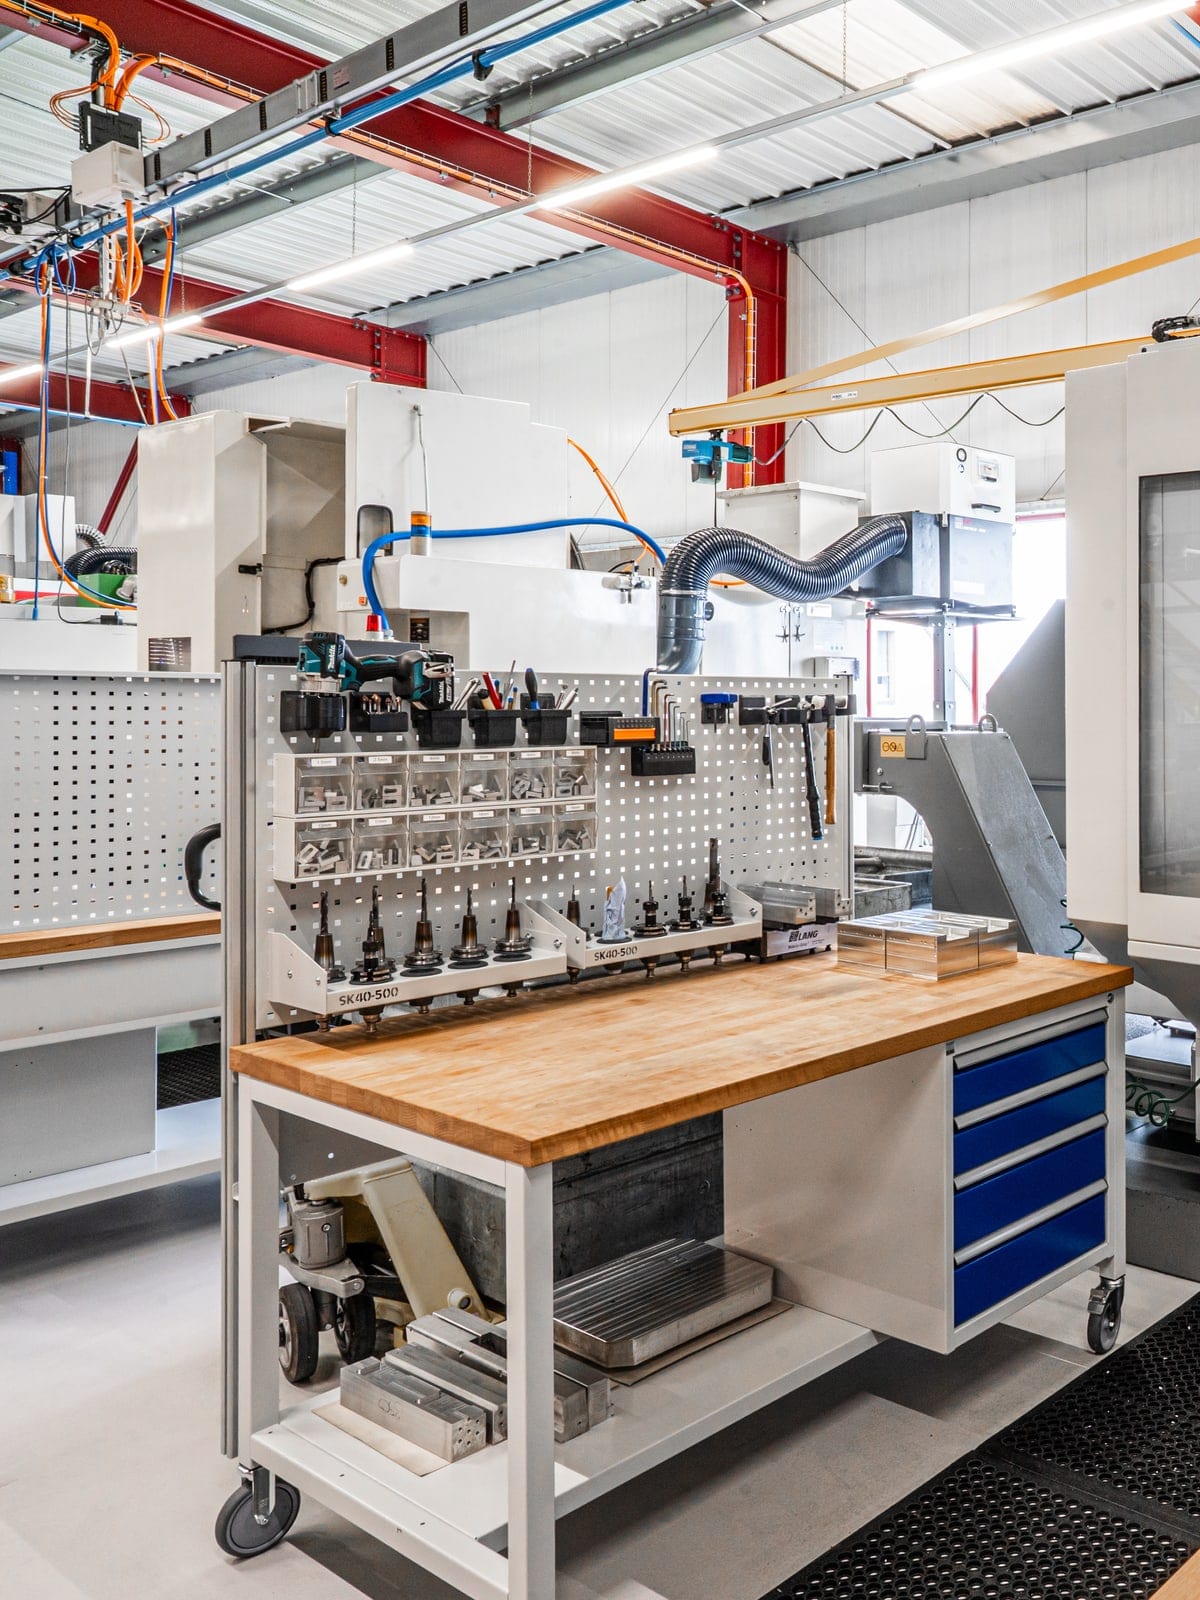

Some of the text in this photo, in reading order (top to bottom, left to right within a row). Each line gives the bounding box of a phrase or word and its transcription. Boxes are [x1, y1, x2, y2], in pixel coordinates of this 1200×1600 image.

[798, 929, 819, 941] LANG
[593, 944, 639, 962] SK40-500
[338, 986, 400, 1007] SK40-500
